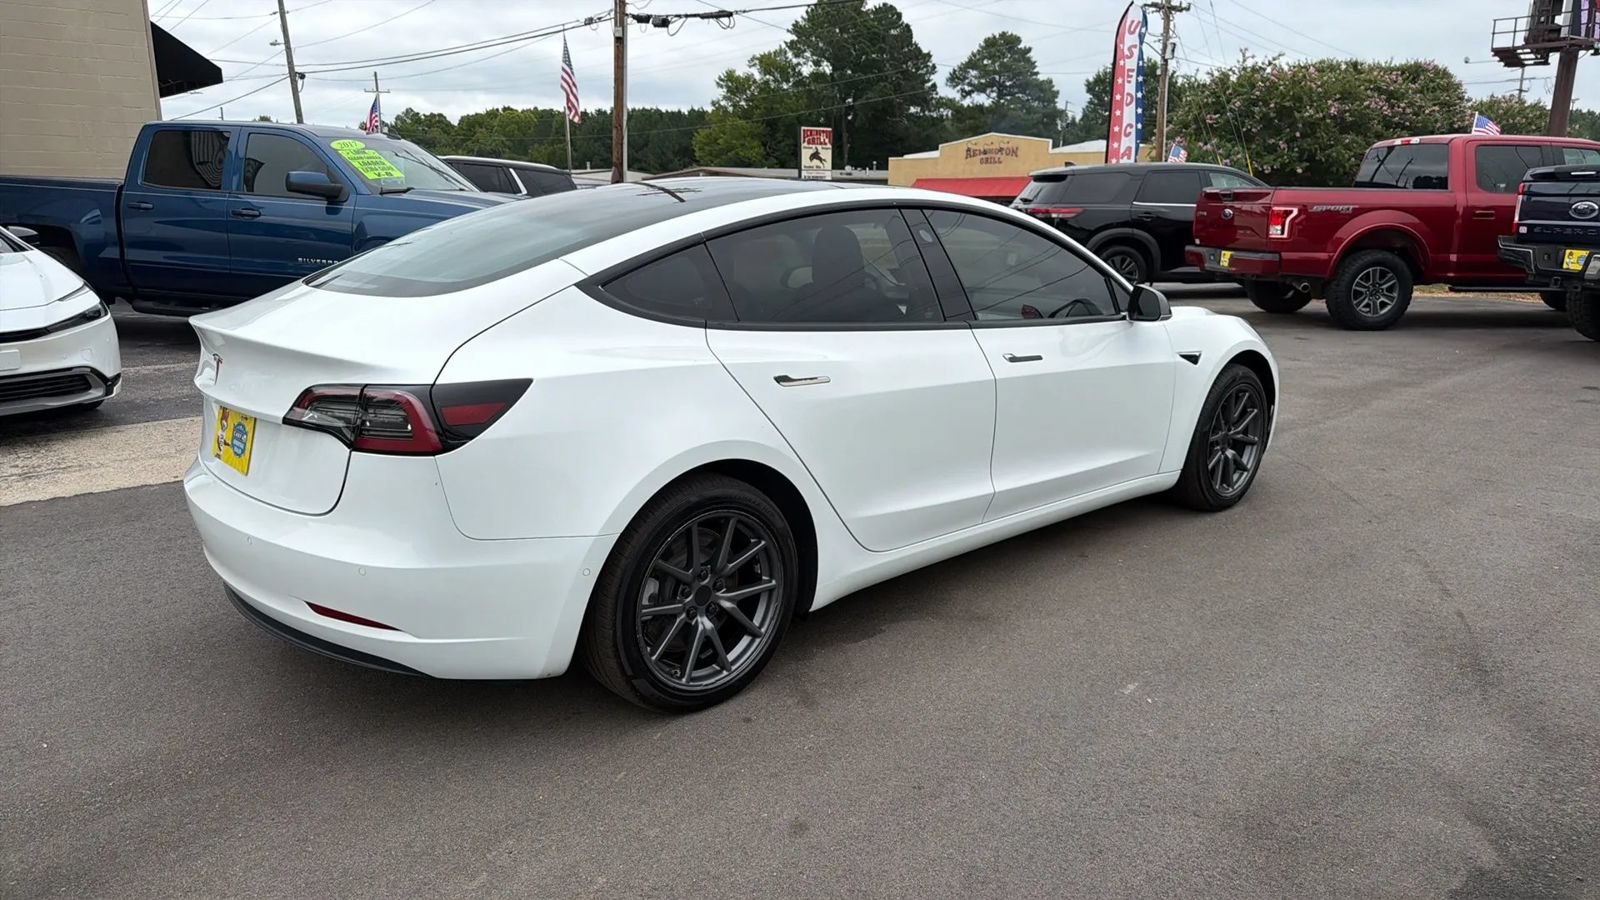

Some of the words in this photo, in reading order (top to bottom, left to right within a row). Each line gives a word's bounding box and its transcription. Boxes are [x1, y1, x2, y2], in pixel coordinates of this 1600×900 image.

[1125, 19, 1141, 107] USED
[1120, 123, 1134, 160] CA
[979, 157, 1003, 165] GRILL
[1308, 204, 1360, 212] SPORT
